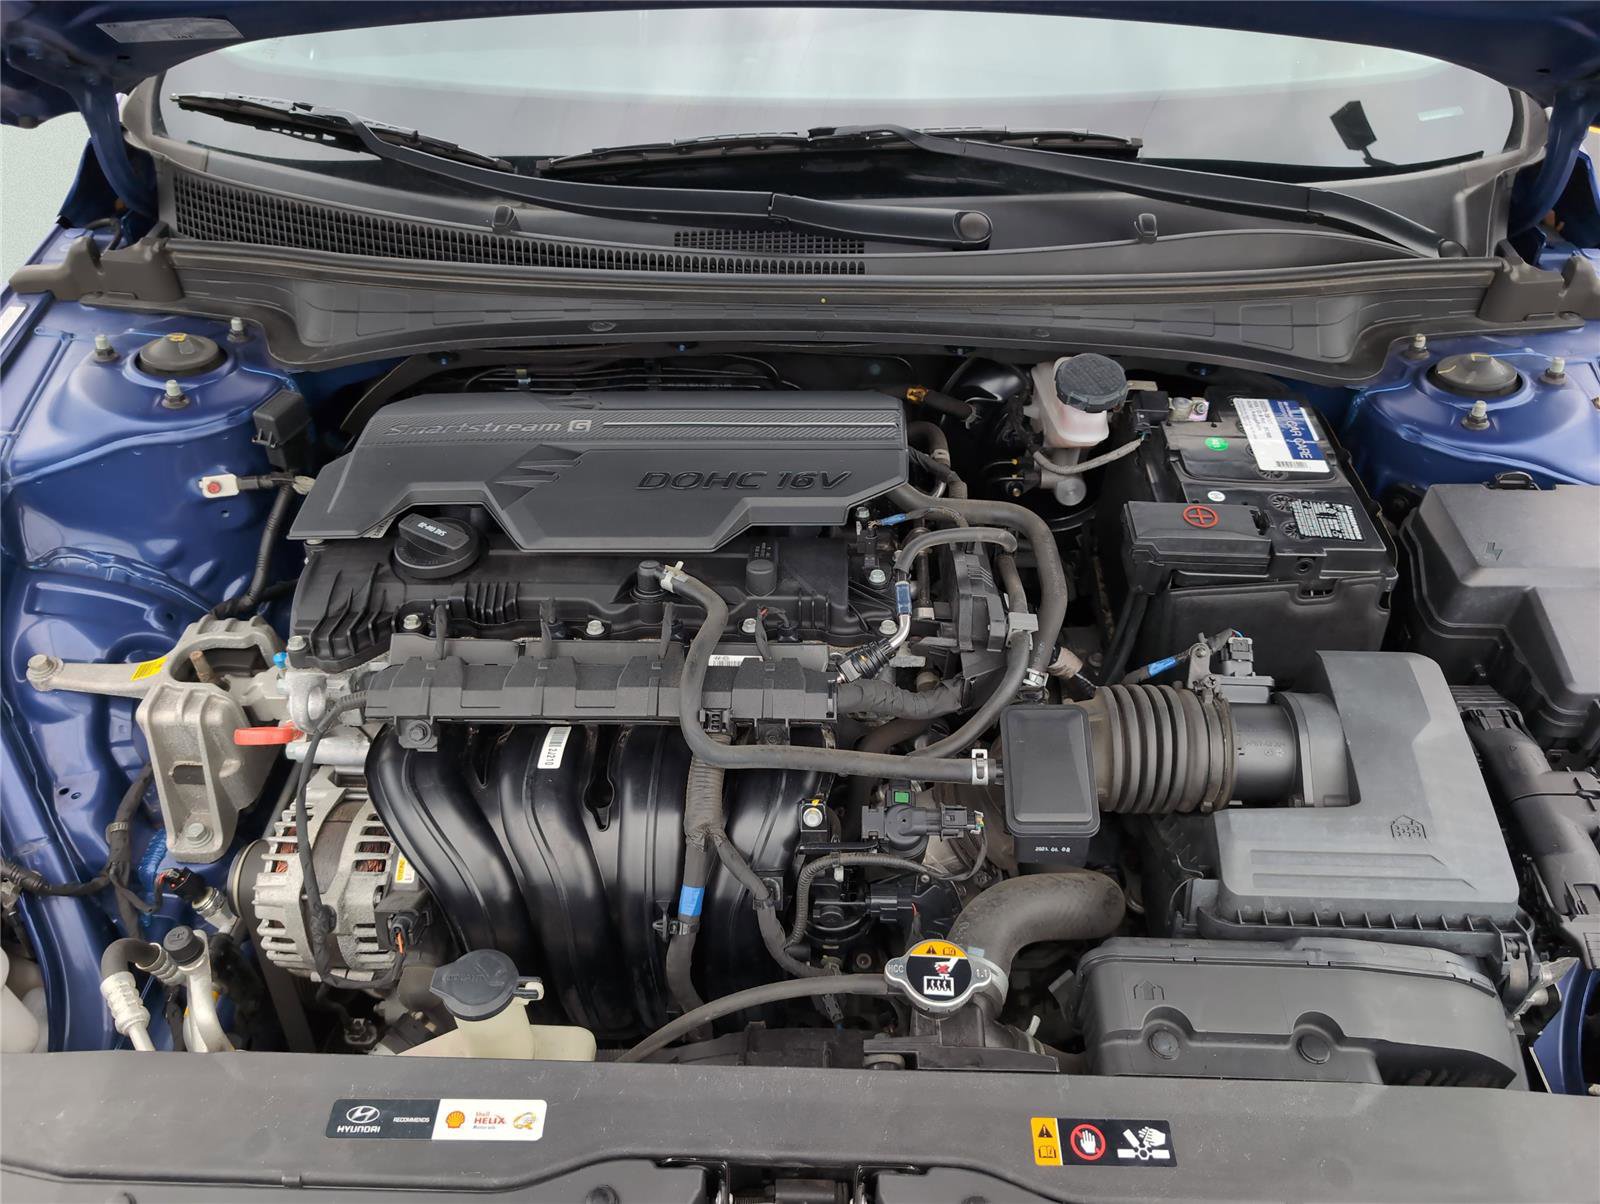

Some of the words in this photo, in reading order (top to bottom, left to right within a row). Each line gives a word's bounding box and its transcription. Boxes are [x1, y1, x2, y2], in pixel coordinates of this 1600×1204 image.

[385, 422, 562, 436] Smartstream
[636, 470, 768, 490] DOHC
[776, 470, 852, 490] 16V
[473, 1116, 506, 1124] HELIX
[337, 1125, 381, 1133] HYUNDAI
